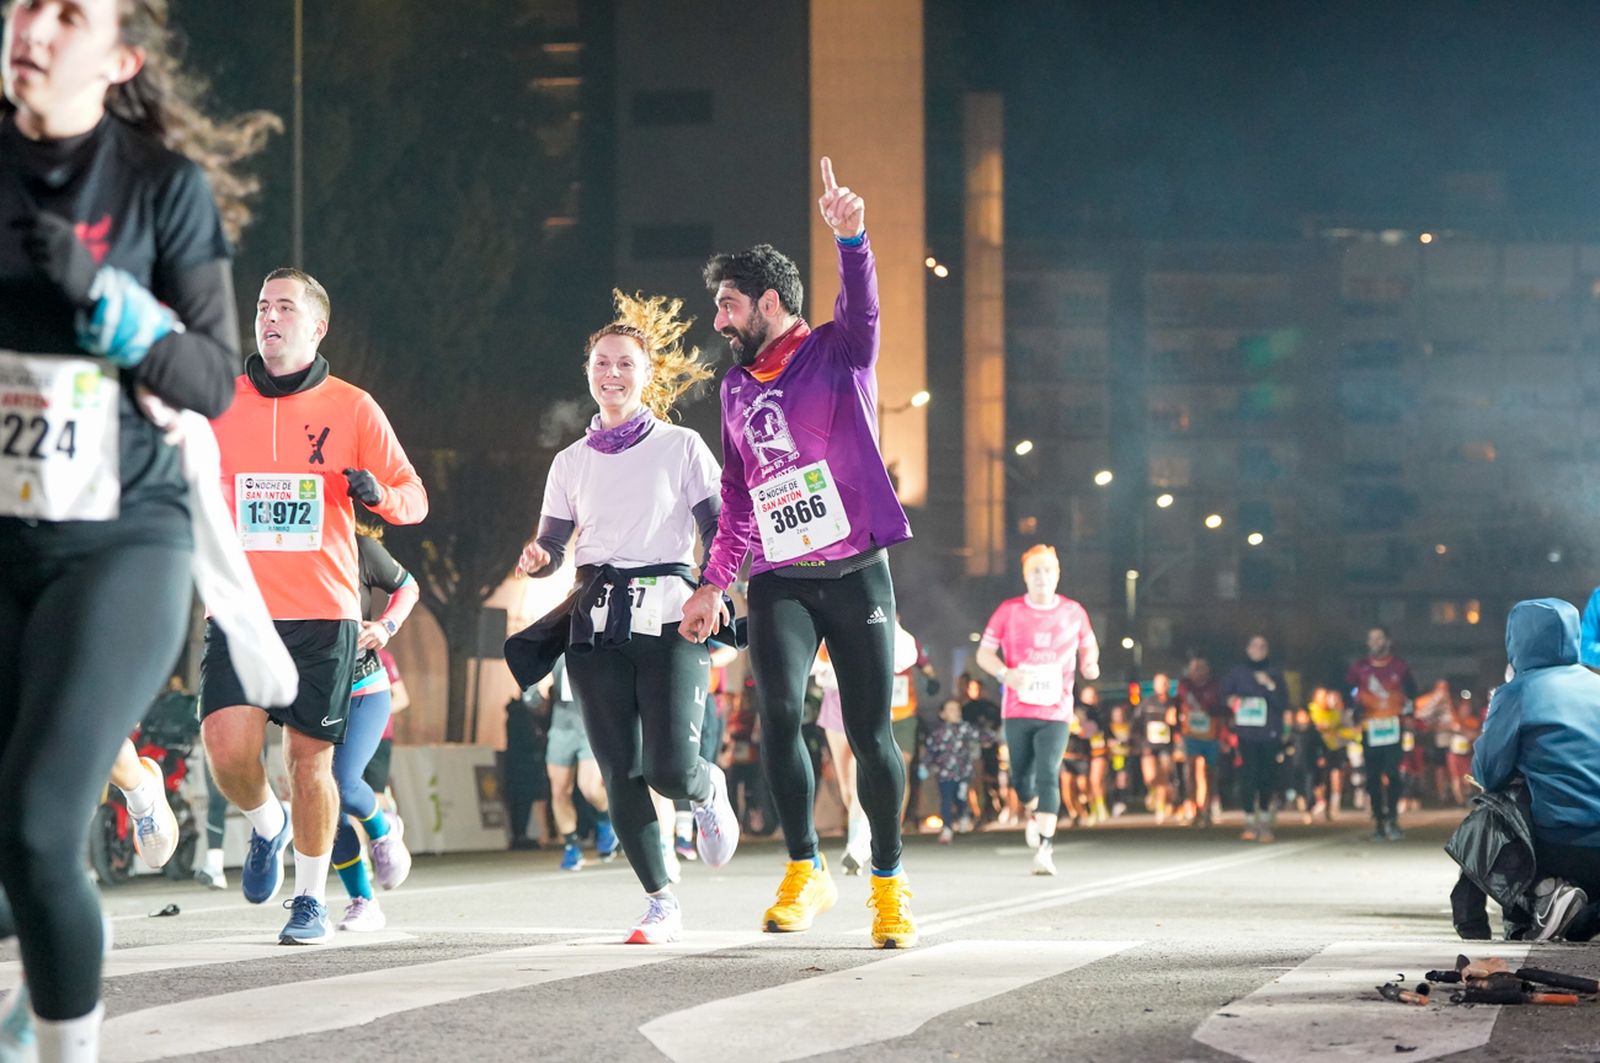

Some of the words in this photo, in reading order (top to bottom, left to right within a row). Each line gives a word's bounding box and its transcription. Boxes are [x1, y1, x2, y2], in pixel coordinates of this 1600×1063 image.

[255, 482, 280, 490] NOCHE
[282, 482, 292, 490] DE
[766, 485, 788, 500] NOCHE
[789, 480, 798, 491] DE
[246, 491, 261, 500] SAN
[248, 501, 311, 525] 13972
[762, 501, 776, 513] SAN
[770, 494, 827, 534] 3866
